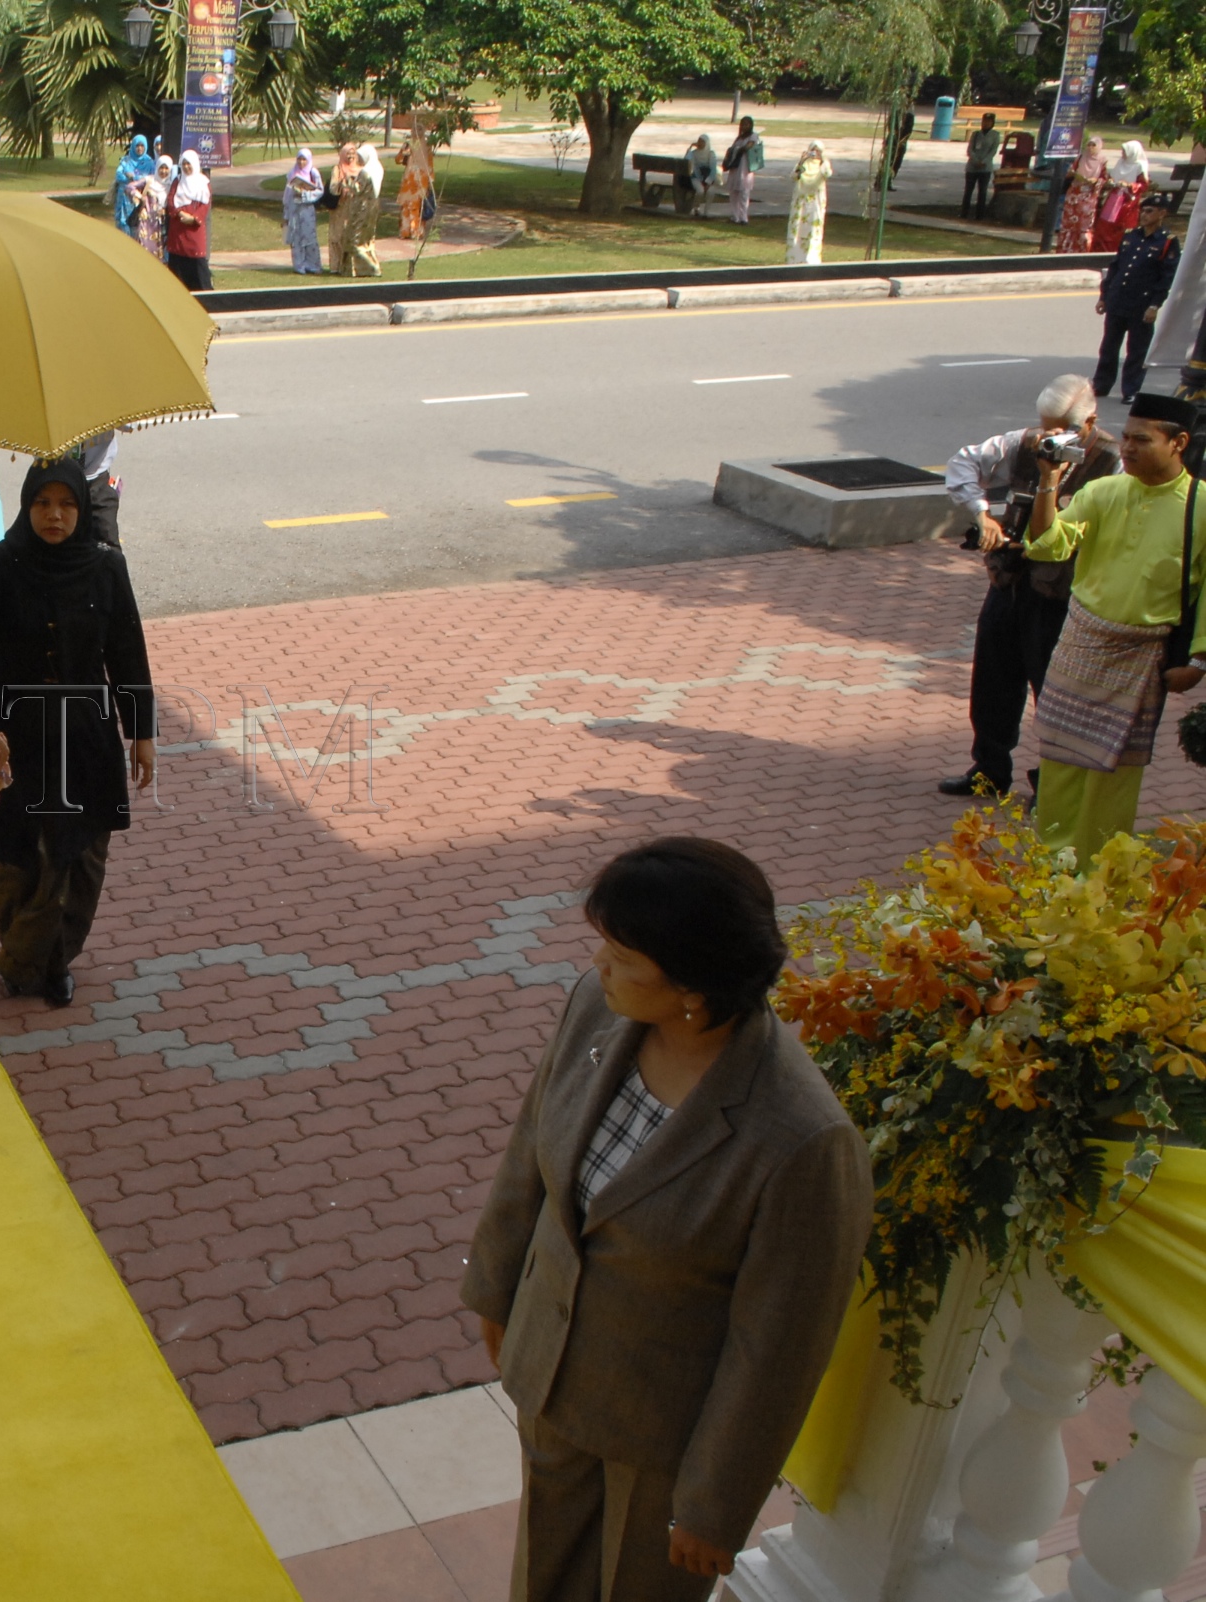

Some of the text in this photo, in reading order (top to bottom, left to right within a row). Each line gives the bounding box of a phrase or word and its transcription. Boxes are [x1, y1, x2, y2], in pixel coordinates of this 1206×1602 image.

[213, 0, 236, 17] Majlis
[188, 24, 236, 36] PERPUSTAKAAN
[188, 36, 213, 45] TUANKU
